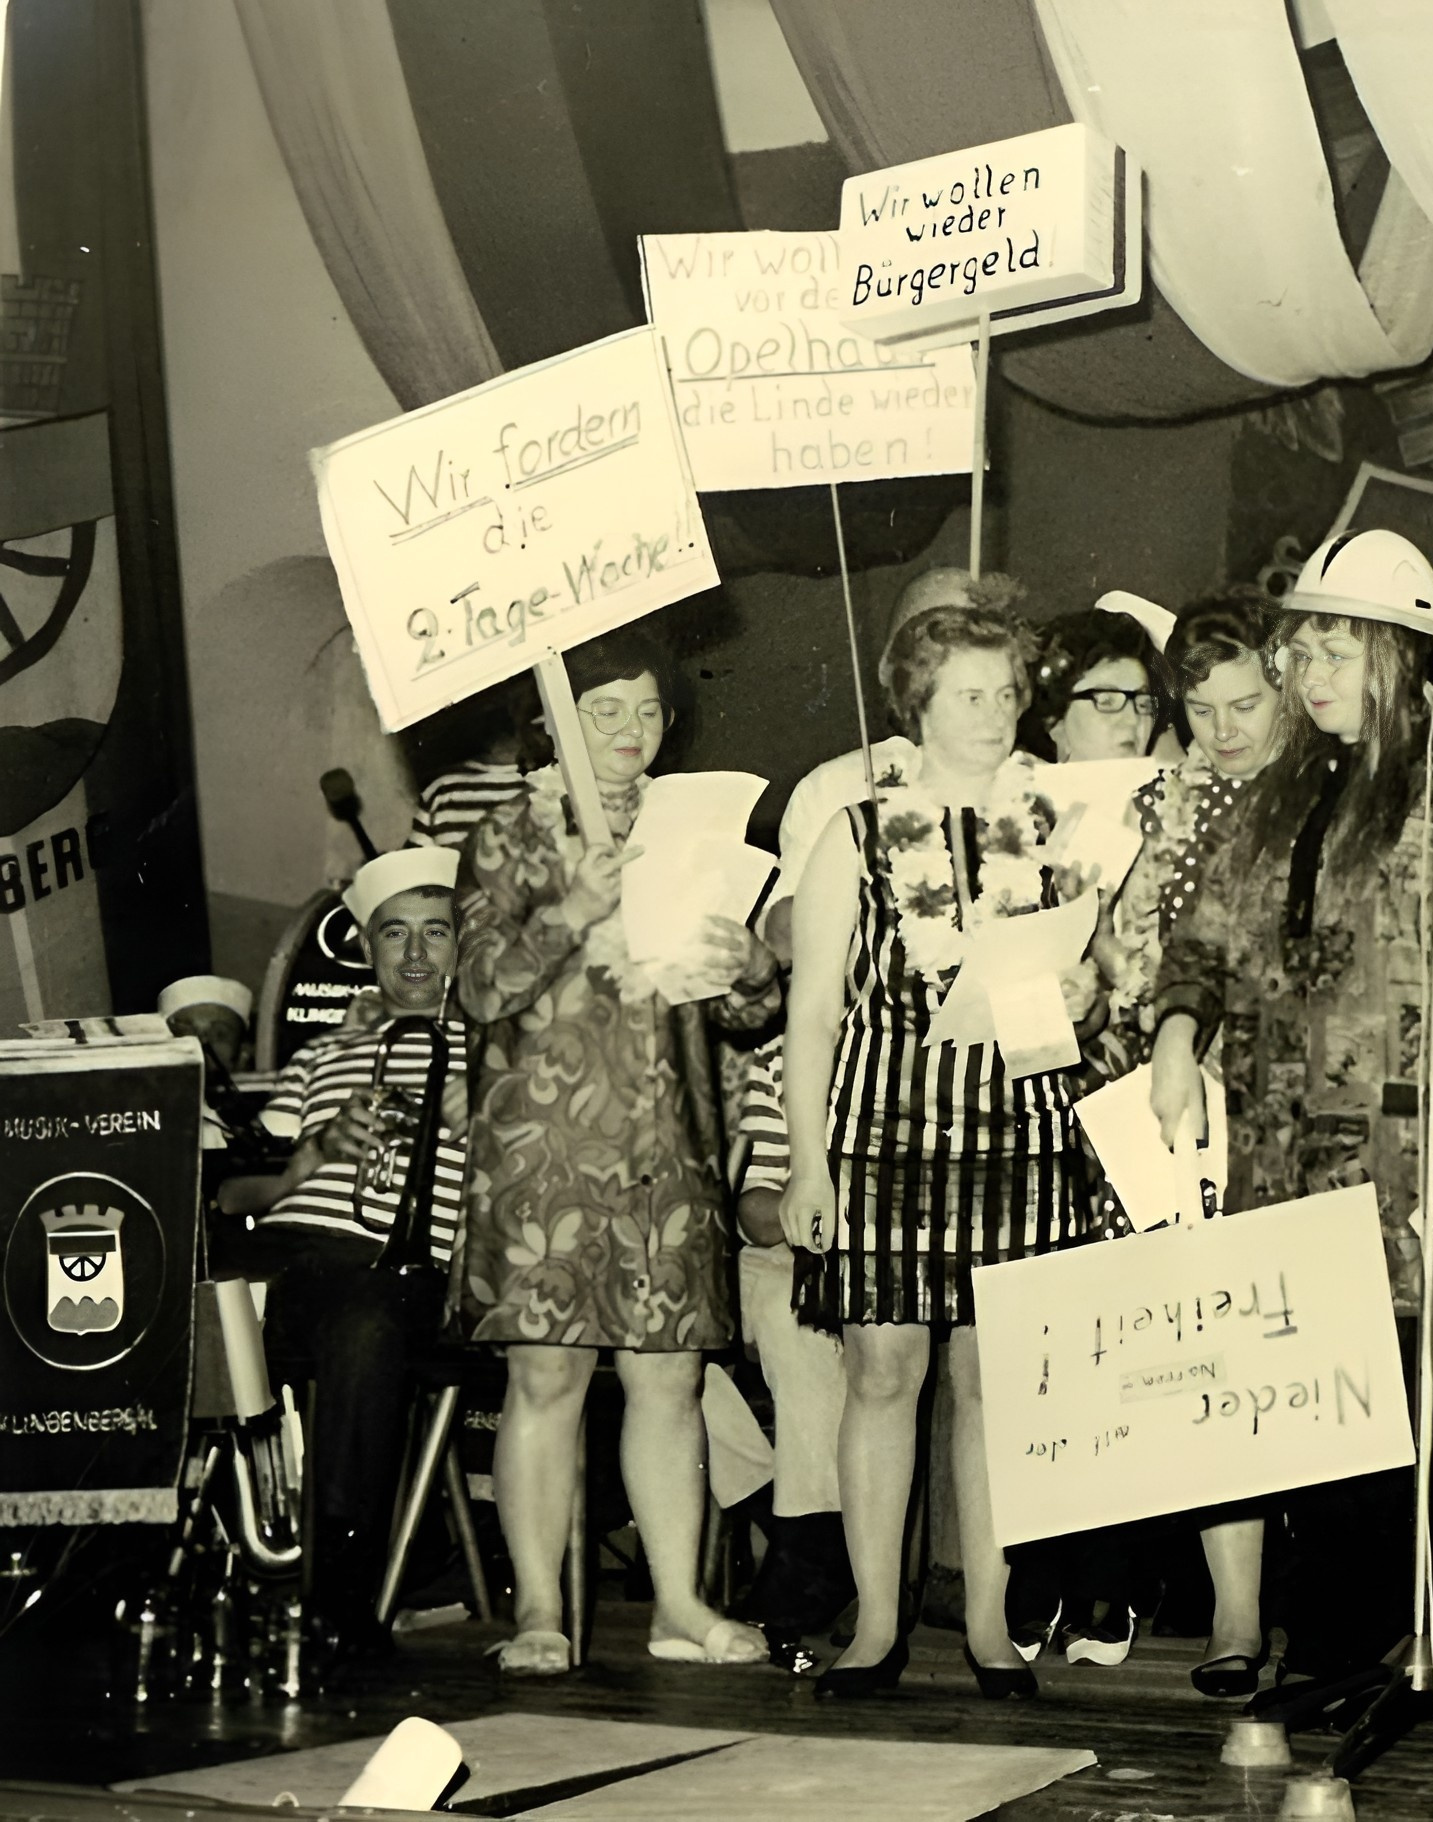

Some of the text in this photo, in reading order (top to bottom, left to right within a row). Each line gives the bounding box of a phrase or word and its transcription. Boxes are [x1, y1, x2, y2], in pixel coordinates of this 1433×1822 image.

[859, 163, 1042, 227] Wir wollen
[906, 205, 1007, 243] wieder
[656, 234, 841, 280] Wir woll
[734, 288, 785, 313] vor
[681, 369, 974, 427] die Linde wieder
[373, 400, 641, 525] Wir fordern
[482, 501, 553, 554] die
[1192, 1357, 1373, 1435] Nieder
[1025, 1438, 1068, 1462] der
